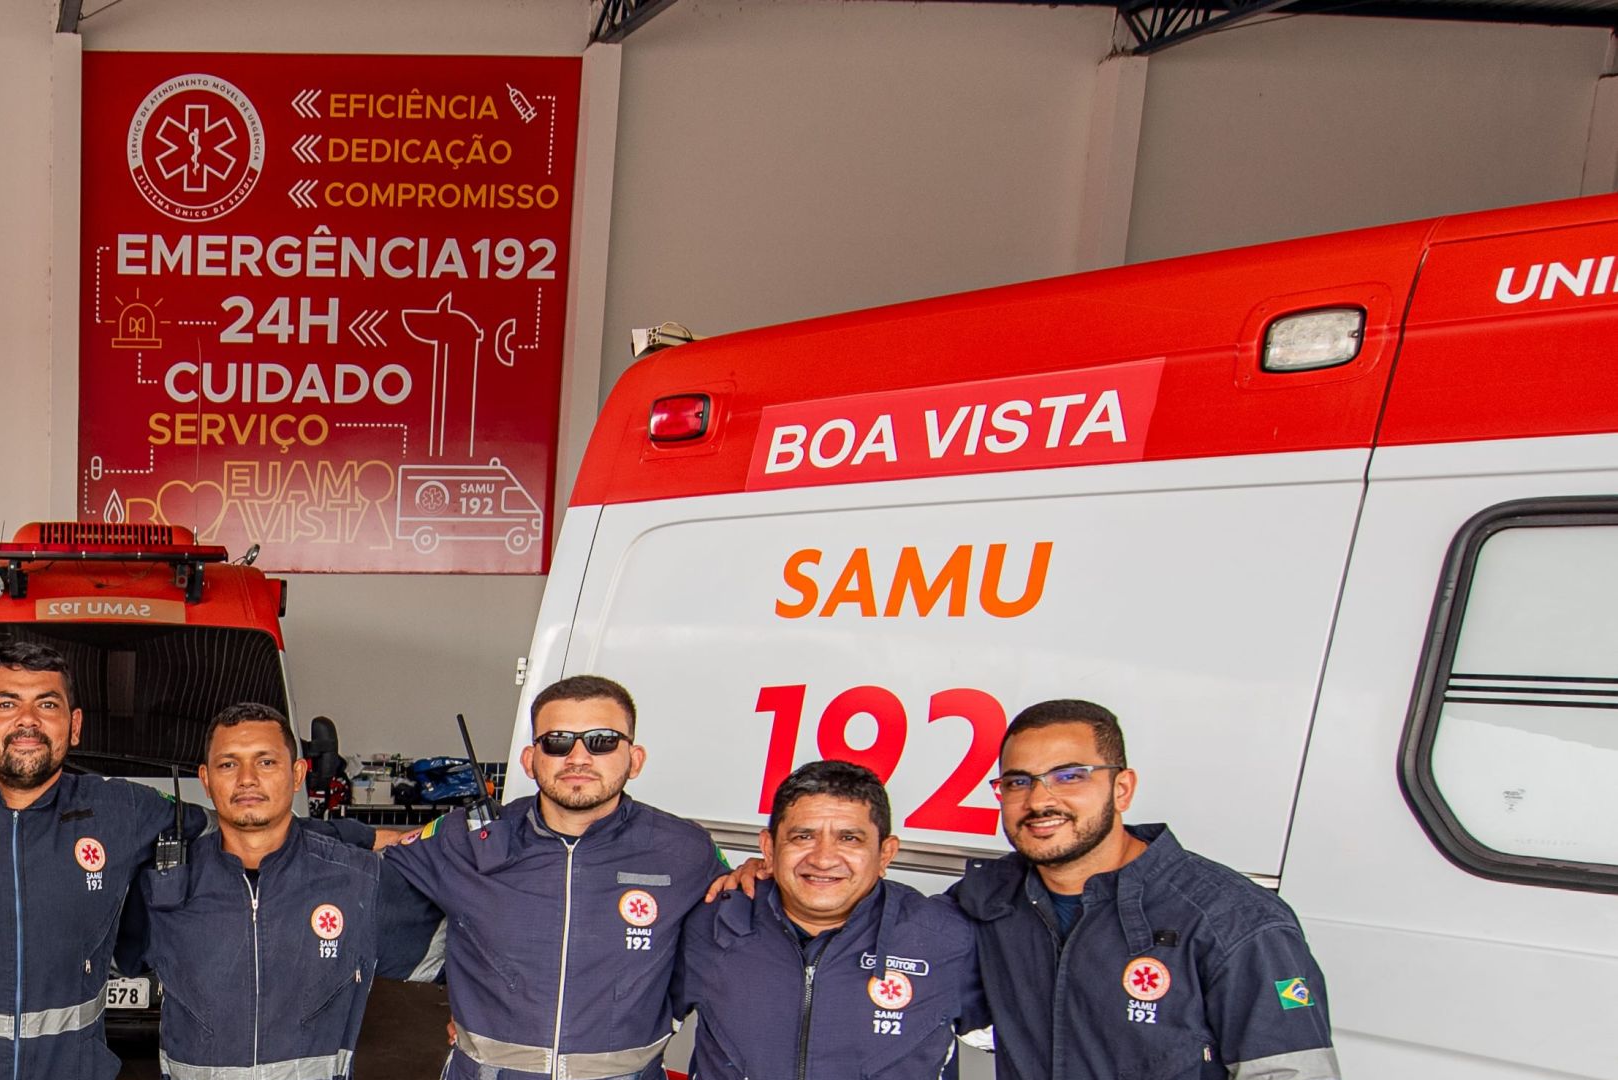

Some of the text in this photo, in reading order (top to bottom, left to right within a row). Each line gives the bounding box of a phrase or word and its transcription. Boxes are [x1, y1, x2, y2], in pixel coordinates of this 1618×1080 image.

[329, 88, 499, 120] EFICIÊNCIA
[132, 79, 260, 161] SERVIÇO DE ATENDIMENTO MÓVEL DE URGÊNCIA
[328, 134, 512, 170] DEDICAÇÃO
[137, 174, 253, 218] SISTEMA ÚNICO DE SAÚDE
[324, 182, 559, 209] COMPROMISSO
[1496, 256, 1618, 304] UNI
[219, 295, 339, 344] 24H
[164, 361, 413, 405] CUIDADO
[148, 412, 329, 454] SERVIÇO
[765, 390, 1126, 474] BOA VISTA
[460, 483, 495, 494] SAMU
[460, 498, 493, 515] 192
[775, 542, 1053, 618] SAMU
[86, 872, 102, 880] SAMU
[86, 880, 103, 890] 192
[626, 928, 652, 936] SAMU
[319, 940, 338, 948] SAMU
[626, 936, 651, 950] 192
[319, 948, 337, 958] 192
[866, 958, 916, 971] CDUTOR
[108, 988, 138, 1004] 578
[1128, 1000, 1157, 1011] SAMU
[874, 1010, 903, 1020] SAMU
[1127, 1009, 1156, 1024] 192
[873, 1020, 901, 1035] 192
